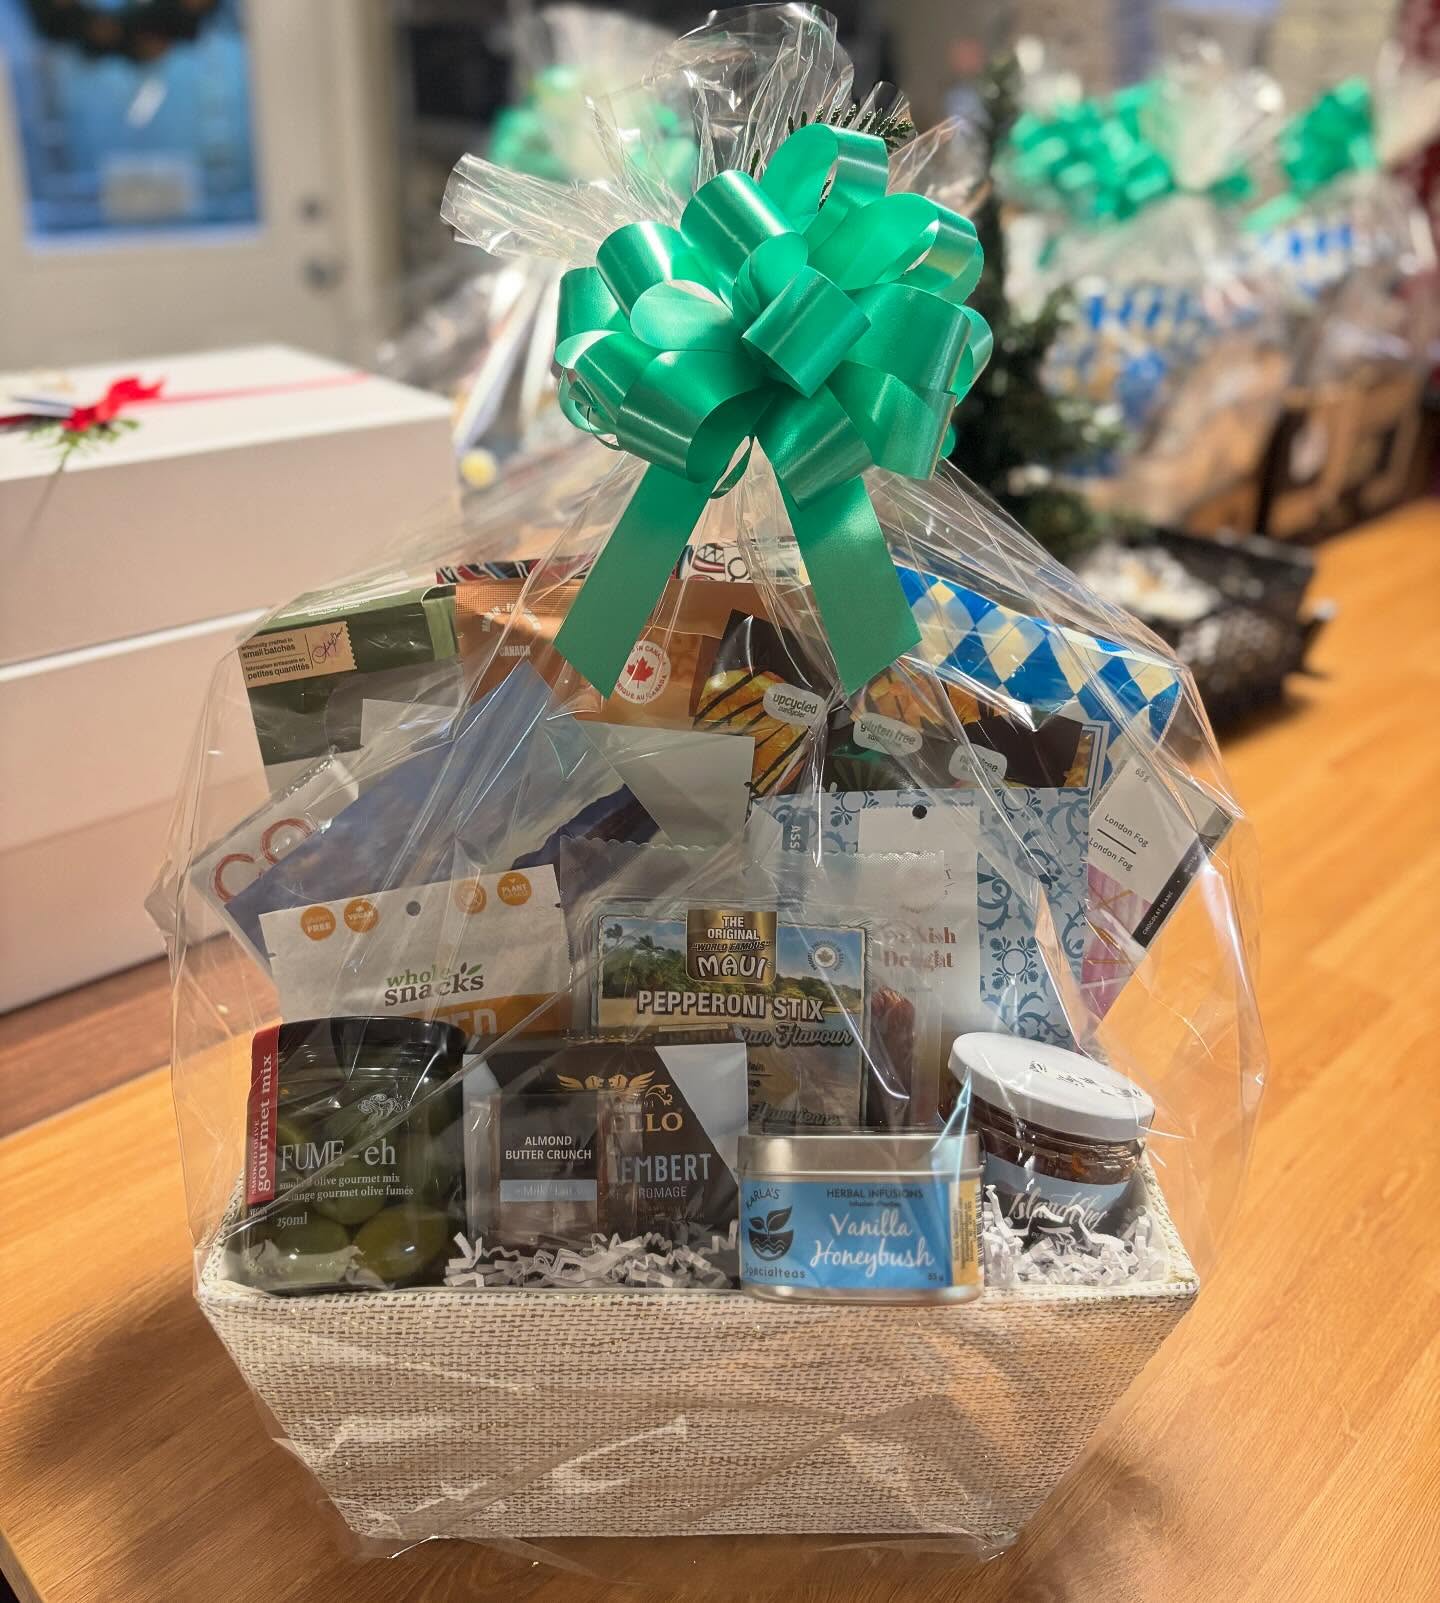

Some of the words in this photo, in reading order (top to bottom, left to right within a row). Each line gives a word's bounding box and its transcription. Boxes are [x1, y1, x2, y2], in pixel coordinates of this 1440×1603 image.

[242, 647, 264, 659] small
[264, 643, 296, 656] batches
[248, 667, 274, 680] petites
[274, 662, 310, 677] quantités
[773, 693, 818, 714] upcycled
[894, 729, 917, 745] free
[1135, 767, 1145, 778] 65
[1104, 813, 1134, 838] London
[1133, 832, 1149, 849] Fog
[1088, 837, 1118, 861] London
[1117, 856, 1134, 872] Fog
[723, 916, 744, 928] THE
[707, 929, 760, 941] ORIGINAL
[387, 964, 451, 988] whole
[697, 953, 767, 981] MAUI
[384, 974, 485, 1007] snacks
[637, 988, 767, 1019] PEPPERONI
[773, 996, 825, 1022] STIX
[775, 1021, 854, 1048] Flavour
[262, 1053, 272, 1094] mix
[257, 1101, 272, 1193] gourmet
[524, 1135, 572, 1146] ALMOND
[505, 1149, 545, 1160] BUTTER
[546, 1149, 592, 1160] CRUNCH
[314, 1176, 337, 1187] olive
[338, 1175, 381, 1188] gourmet
[382, 1172, 401, 1184] mix
[317, 1187, 359, 1201] gourmet
[360, 1186, 384, 1197] olive
[386, 1184, 414, 1196] fumée
[634, 1185, 688, 1200] ROMAGE
[826, 1188, 866, 1199] HERBAL
[868, 1188, 924, 1199] INFUSIONS
[276, 1211, 308, 1229] 250ml
[830, 1207, 913, 1237] Vanilla
[809, 1236, 935, 1278] Honeybush
